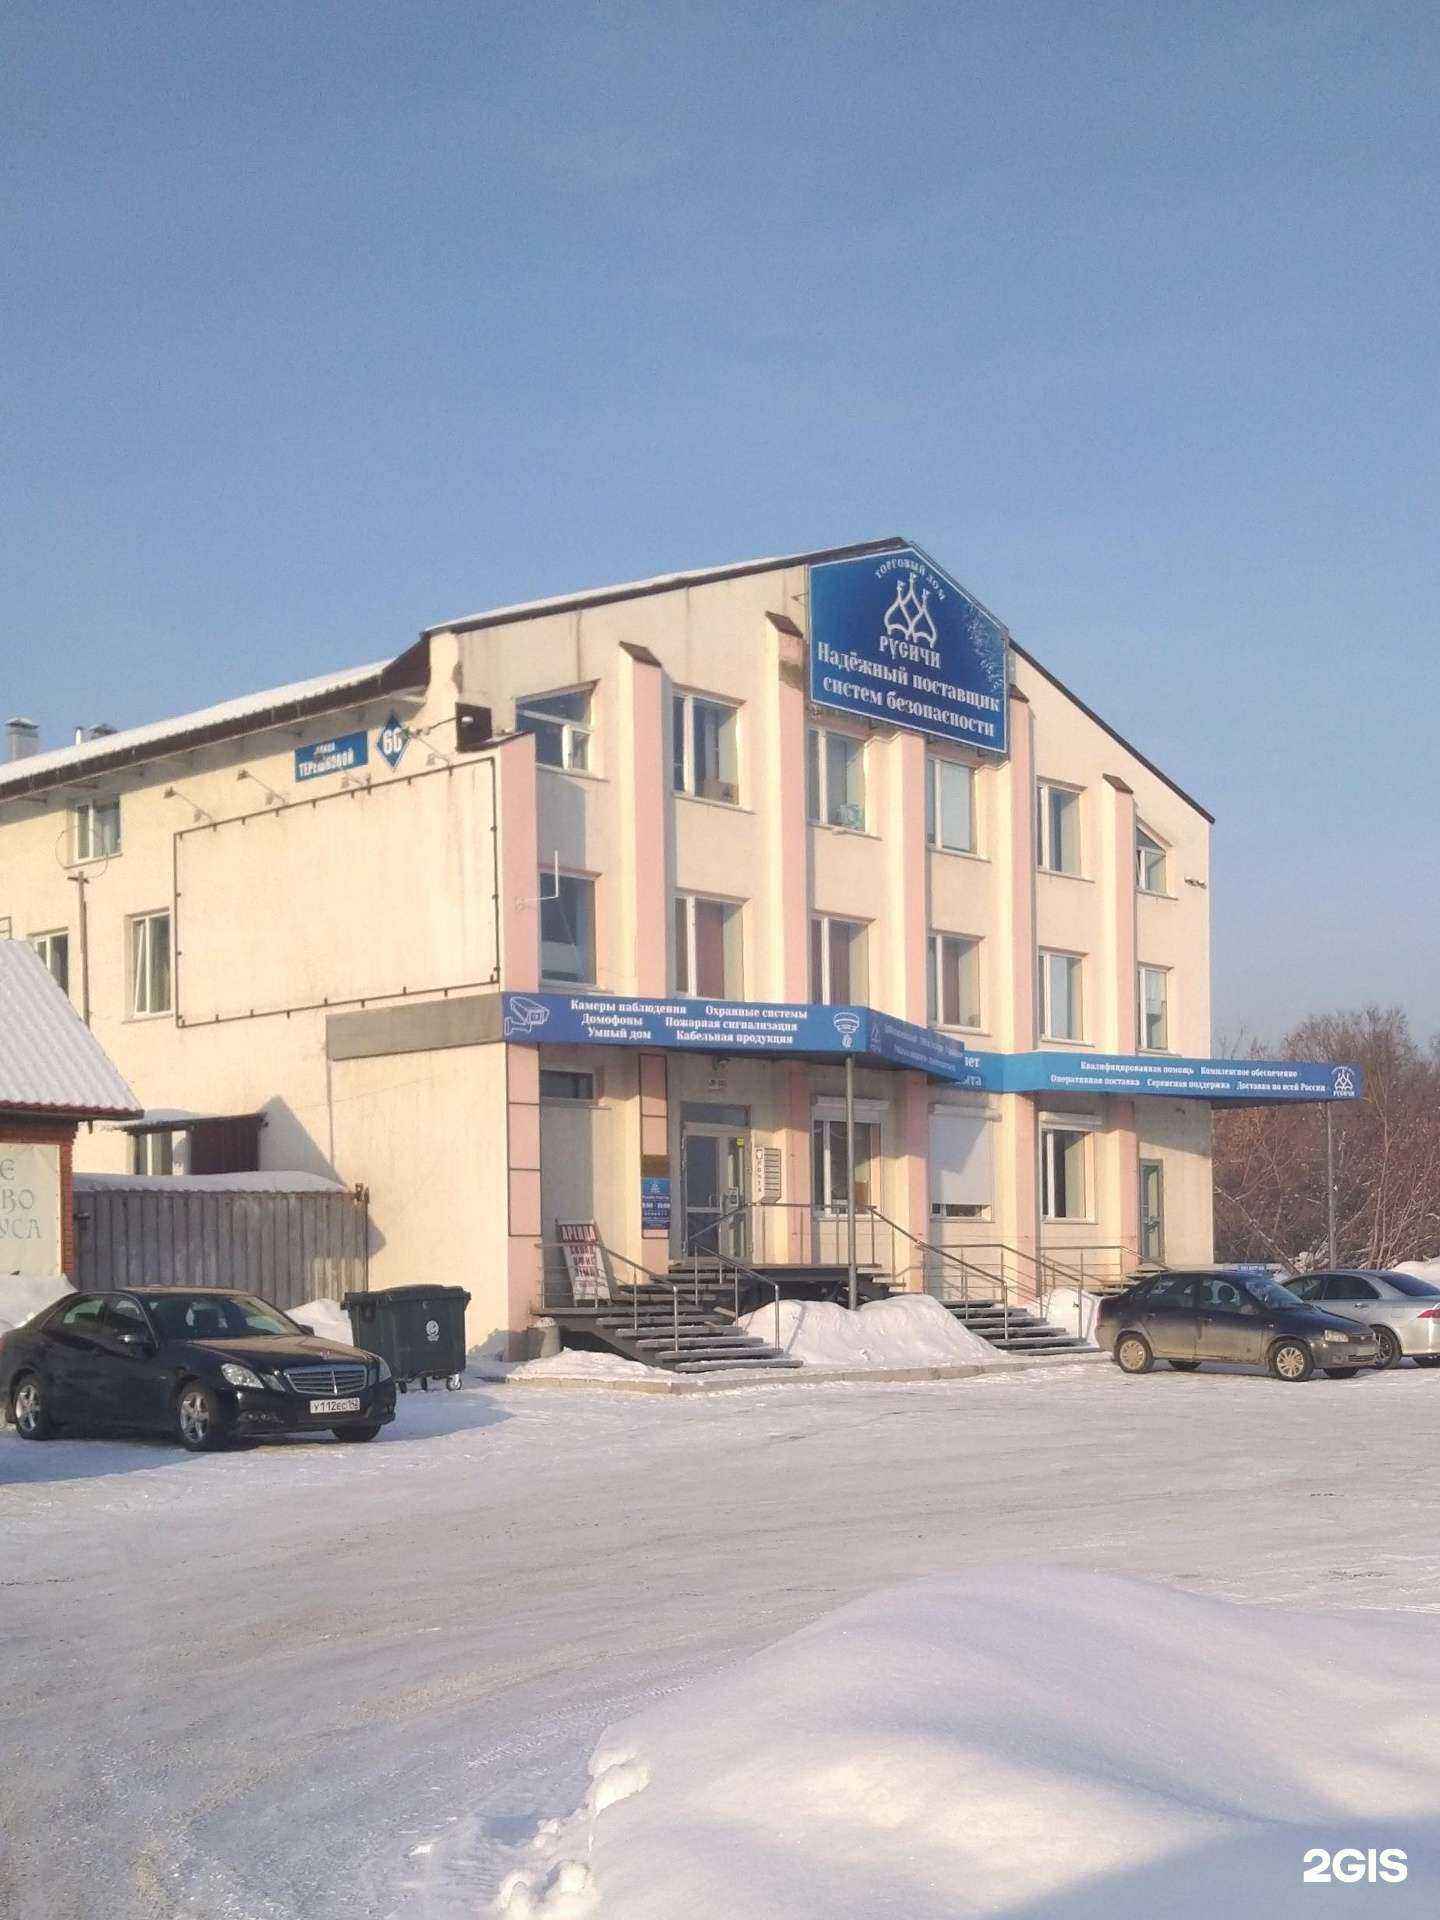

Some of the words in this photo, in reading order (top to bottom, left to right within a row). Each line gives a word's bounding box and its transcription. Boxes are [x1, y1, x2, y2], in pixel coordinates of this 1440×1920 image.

[879, 636, 941, 668] РУСИЧИ
[817, 641, 908, 686] Надёжный
[912, 670, 999, 712] поставщик
[822, 675, 883, 706] систем
[886, 689, 994, 737] безопасности
[570, 999, 616, 1014] Камеры
[618, 1002, 687, 1015] наблюдения
[705, 1004, 760, 1018] Охранные
[762, 1009, 807, 1019] системы
[581, 1013, 643, 1026] Домофоны
[665, 1016, 720, 1030] Пожарная
[722, 1020, 798, 1033] сигнализация
[587, 1025, 627, 1038] Умный
[629, 1029, 652, 1040] дом
[676, 1030, 733, 1042] Кабельная
[735, 1033, 793, 1045] продукция
[1163, 1066, 1194, 1076] помощь
[1104, 1078, 1140, 1087] поставка
[1300, 1083, 1327, 1092] России
[561, 1225, 596, 1242] АРЕНДА
